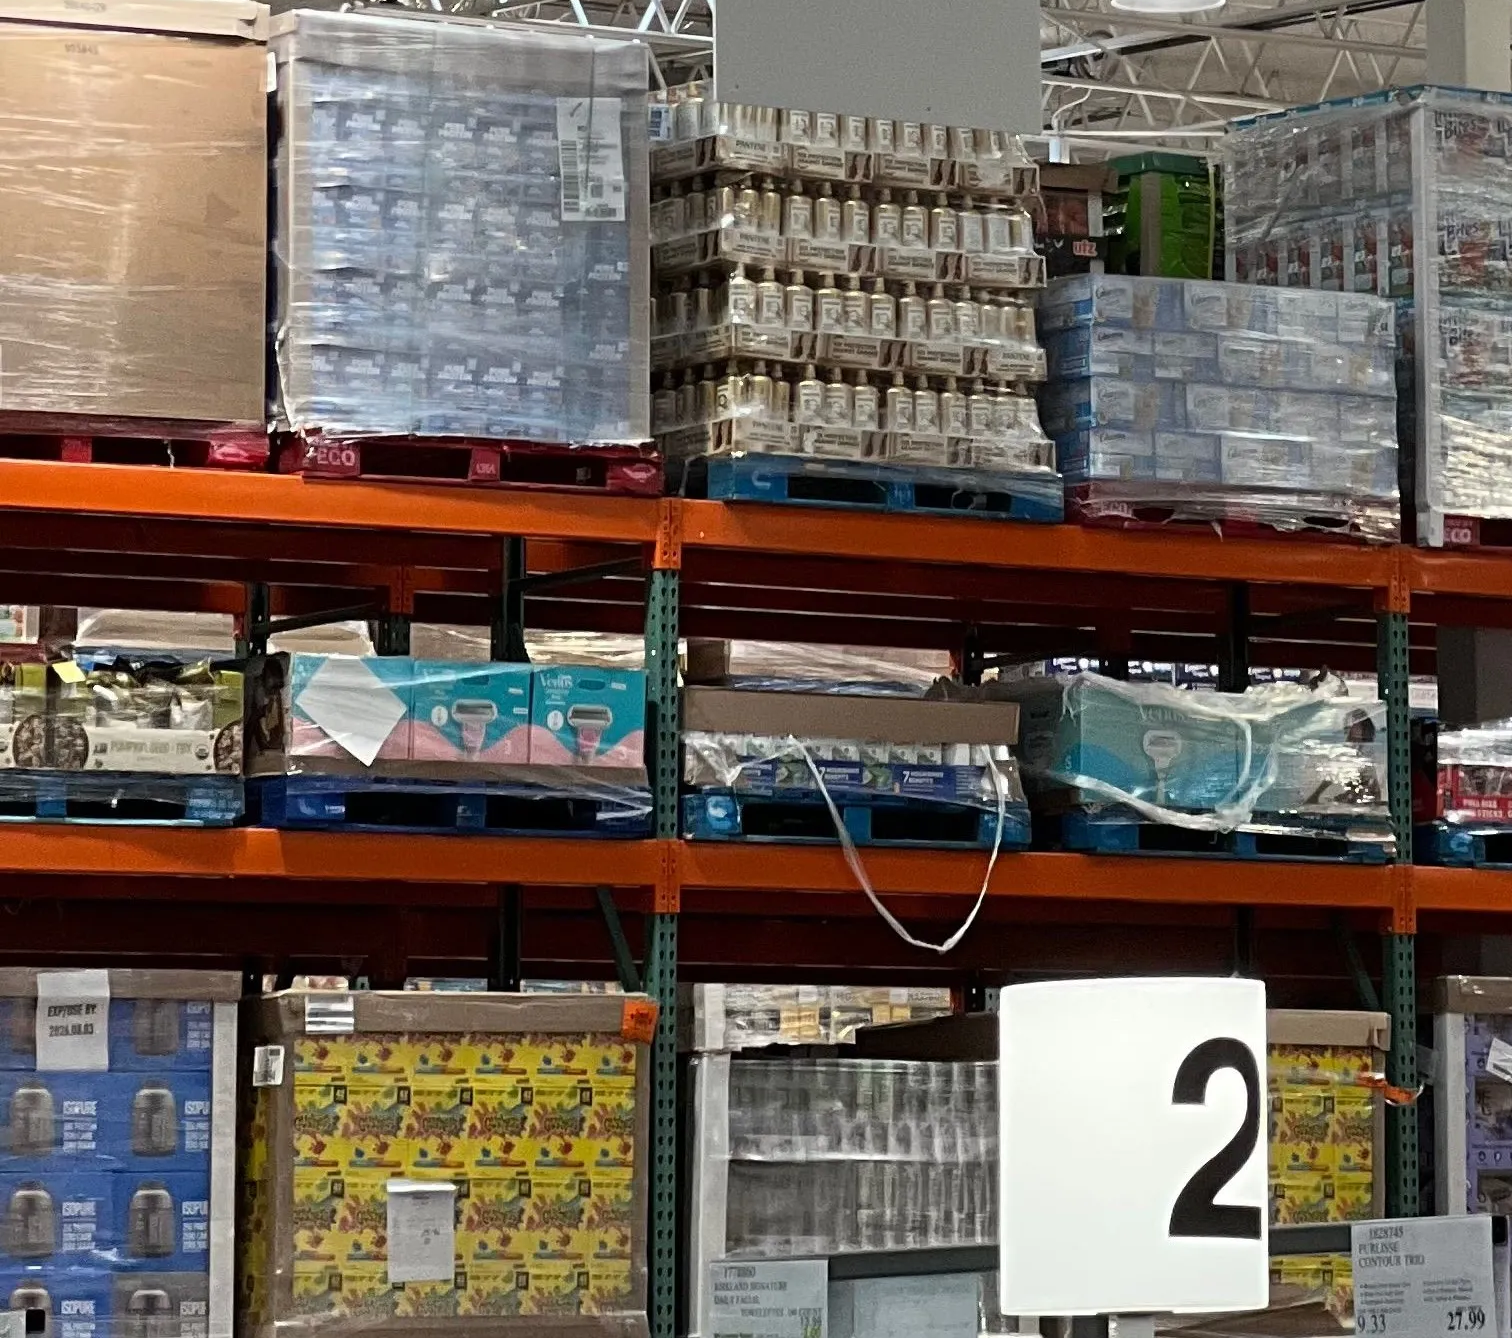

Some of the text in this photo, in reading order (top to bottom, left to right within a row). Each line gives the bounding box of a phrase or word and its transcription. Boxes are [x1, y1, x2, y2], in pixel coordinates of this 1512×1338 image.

[1168, 1036, 1262, 1240] 2
[1359, 1254, 1425, 1268] CONTOUR TRIO
[1358, 1314, 1386, 1333] 9.33
[1447, 1309, 1485, 1331] 27.99
